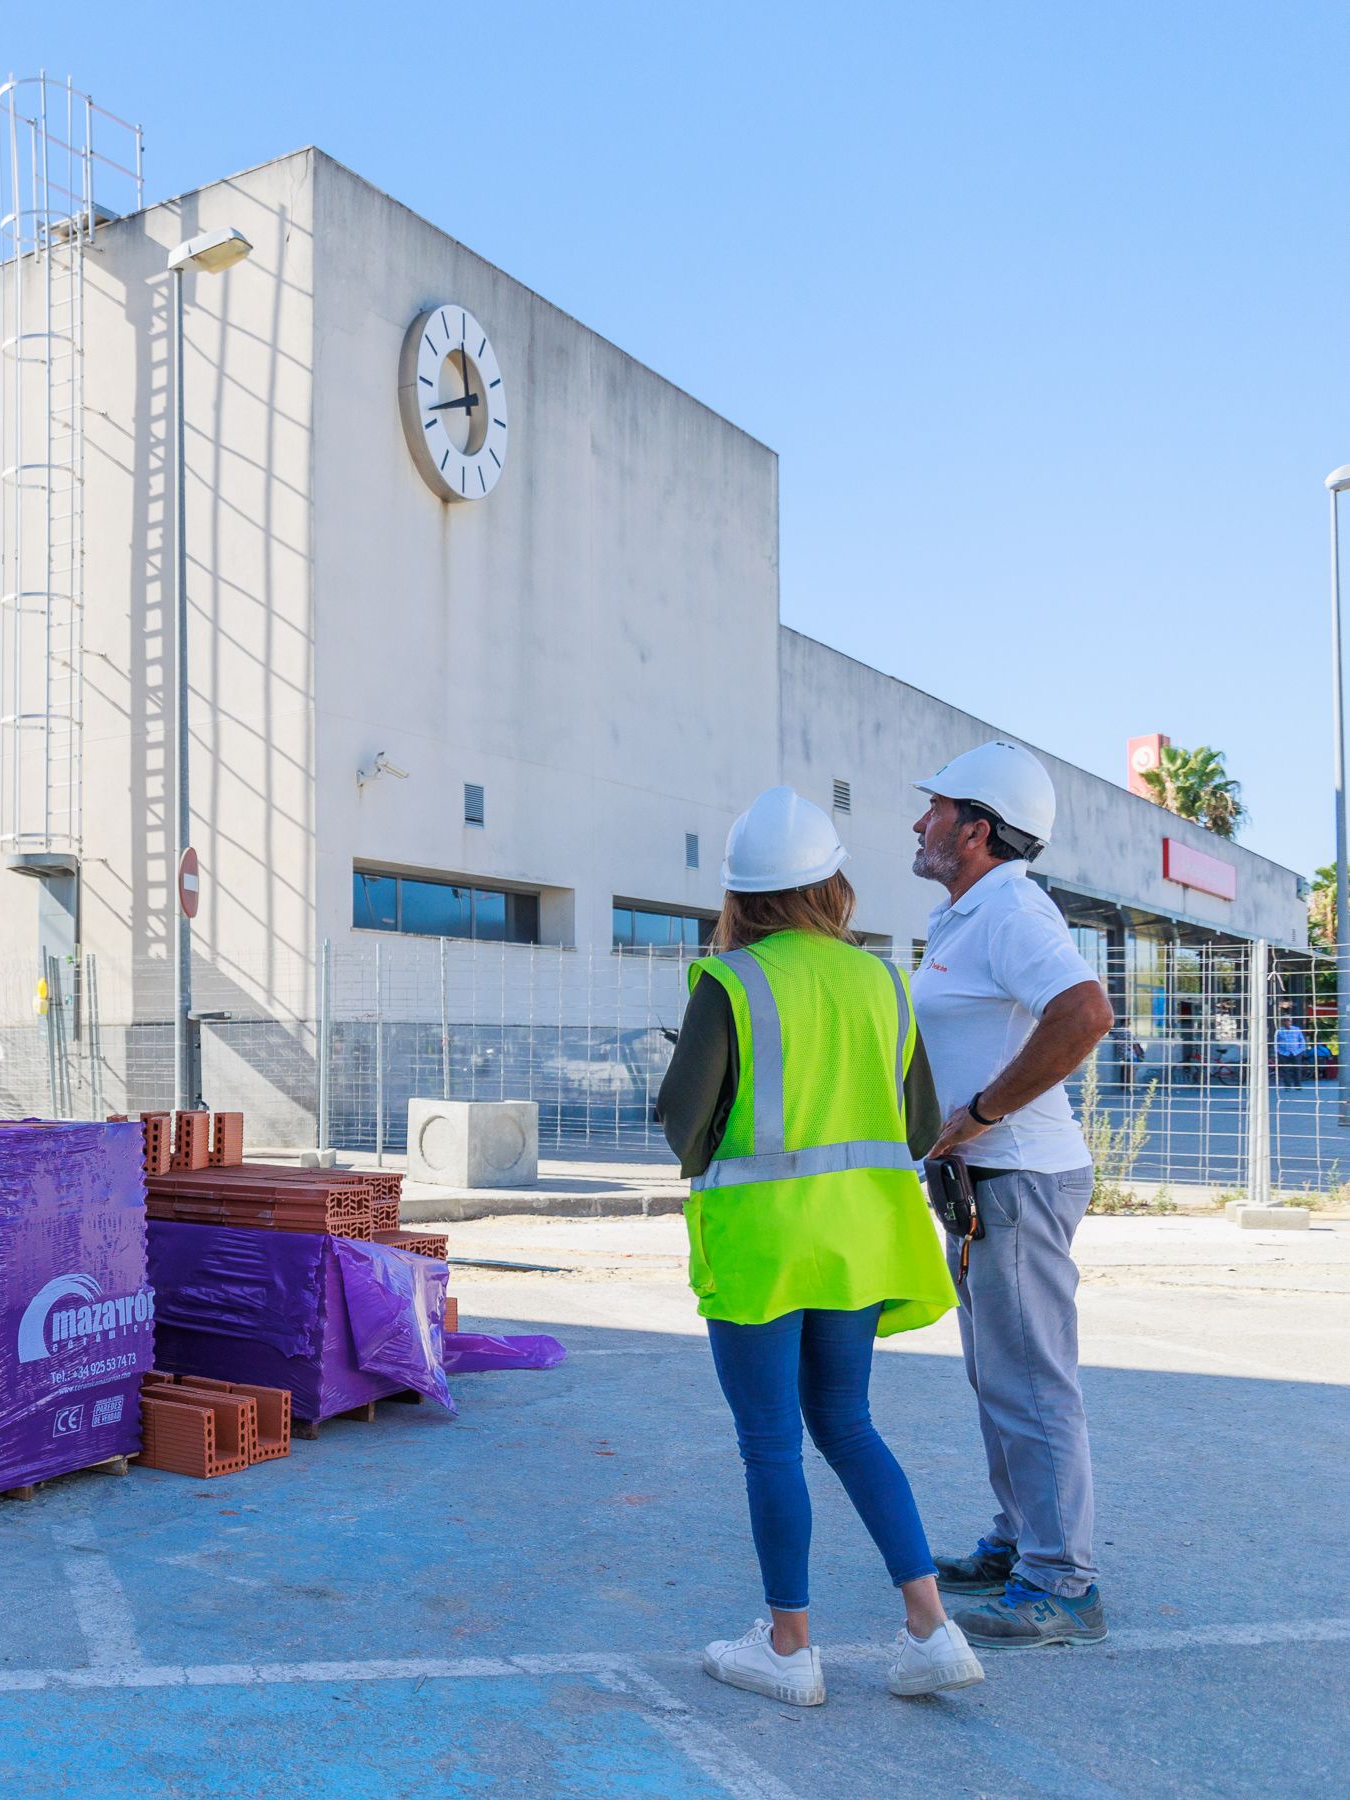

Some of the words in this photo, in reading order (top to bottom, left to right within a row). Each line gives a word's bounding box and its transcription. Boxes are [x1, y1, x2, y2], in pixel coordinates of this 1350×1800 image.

[90, 1360, 106, 1376] 925
[106, 1357, 116, 1372] 53
[117, 1354, 127, 1368] 74
[127, 1352, 137, 1366] 73
